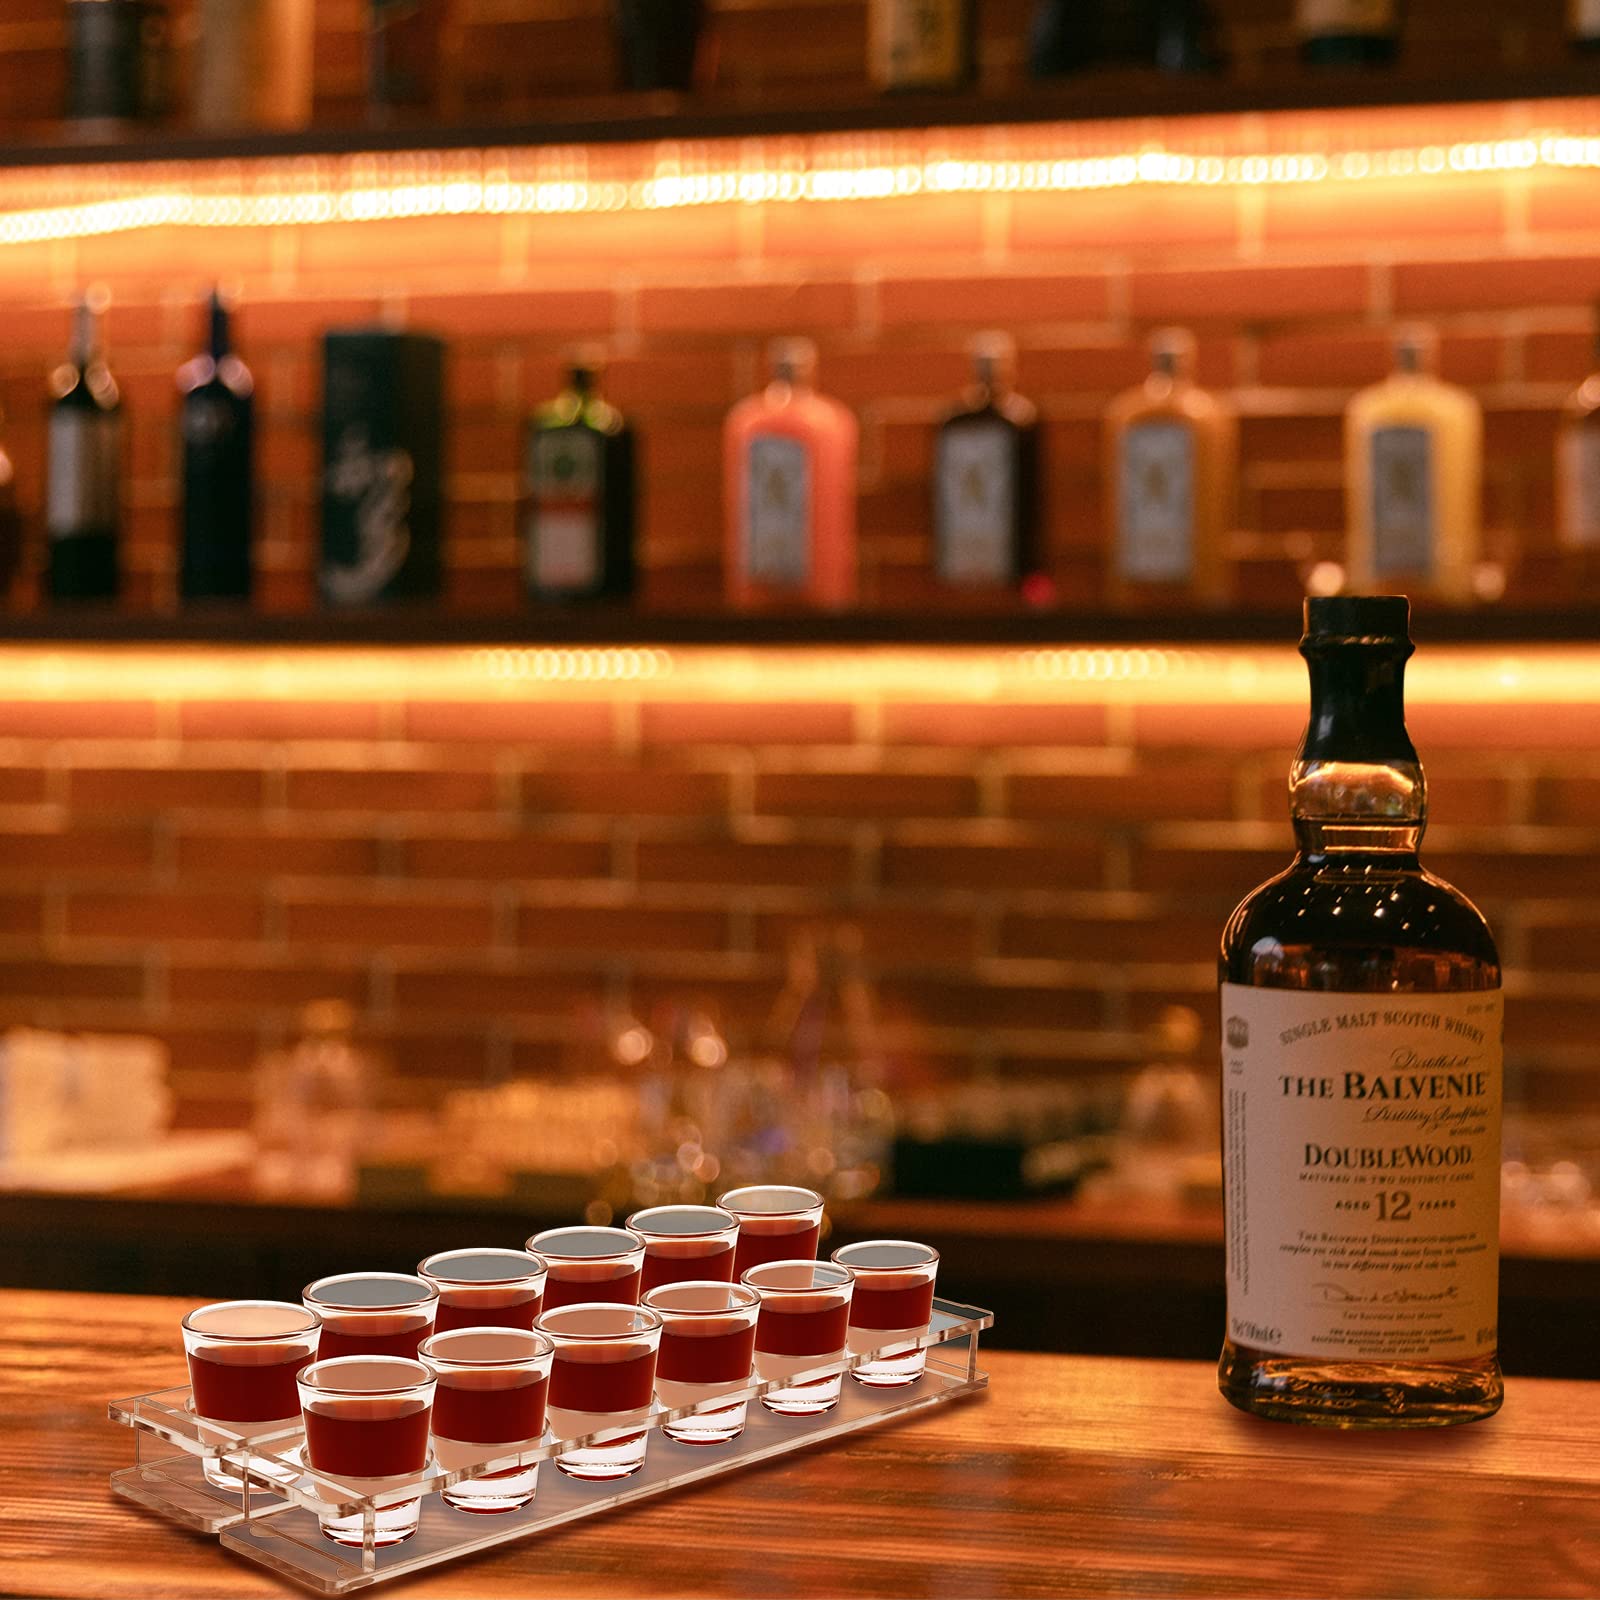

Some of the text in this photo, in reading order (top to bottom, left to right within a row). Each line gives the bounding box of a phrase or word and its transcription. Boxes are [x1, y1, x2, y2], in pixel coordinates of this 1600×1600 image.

[1279, 1017, 1332, 1046] SINGLE
[1336, 1010, 1378, 1029] MALT
[1383, 1010, 1441, 1030] SCOTCH
[1278, 1071, 1487, 1100] THE BALVENIE
[1303, 1142, 1473, 1169] DOUBLEWOOD
[1335, 1190, 1457, 1223] AGED 12 YEARS
